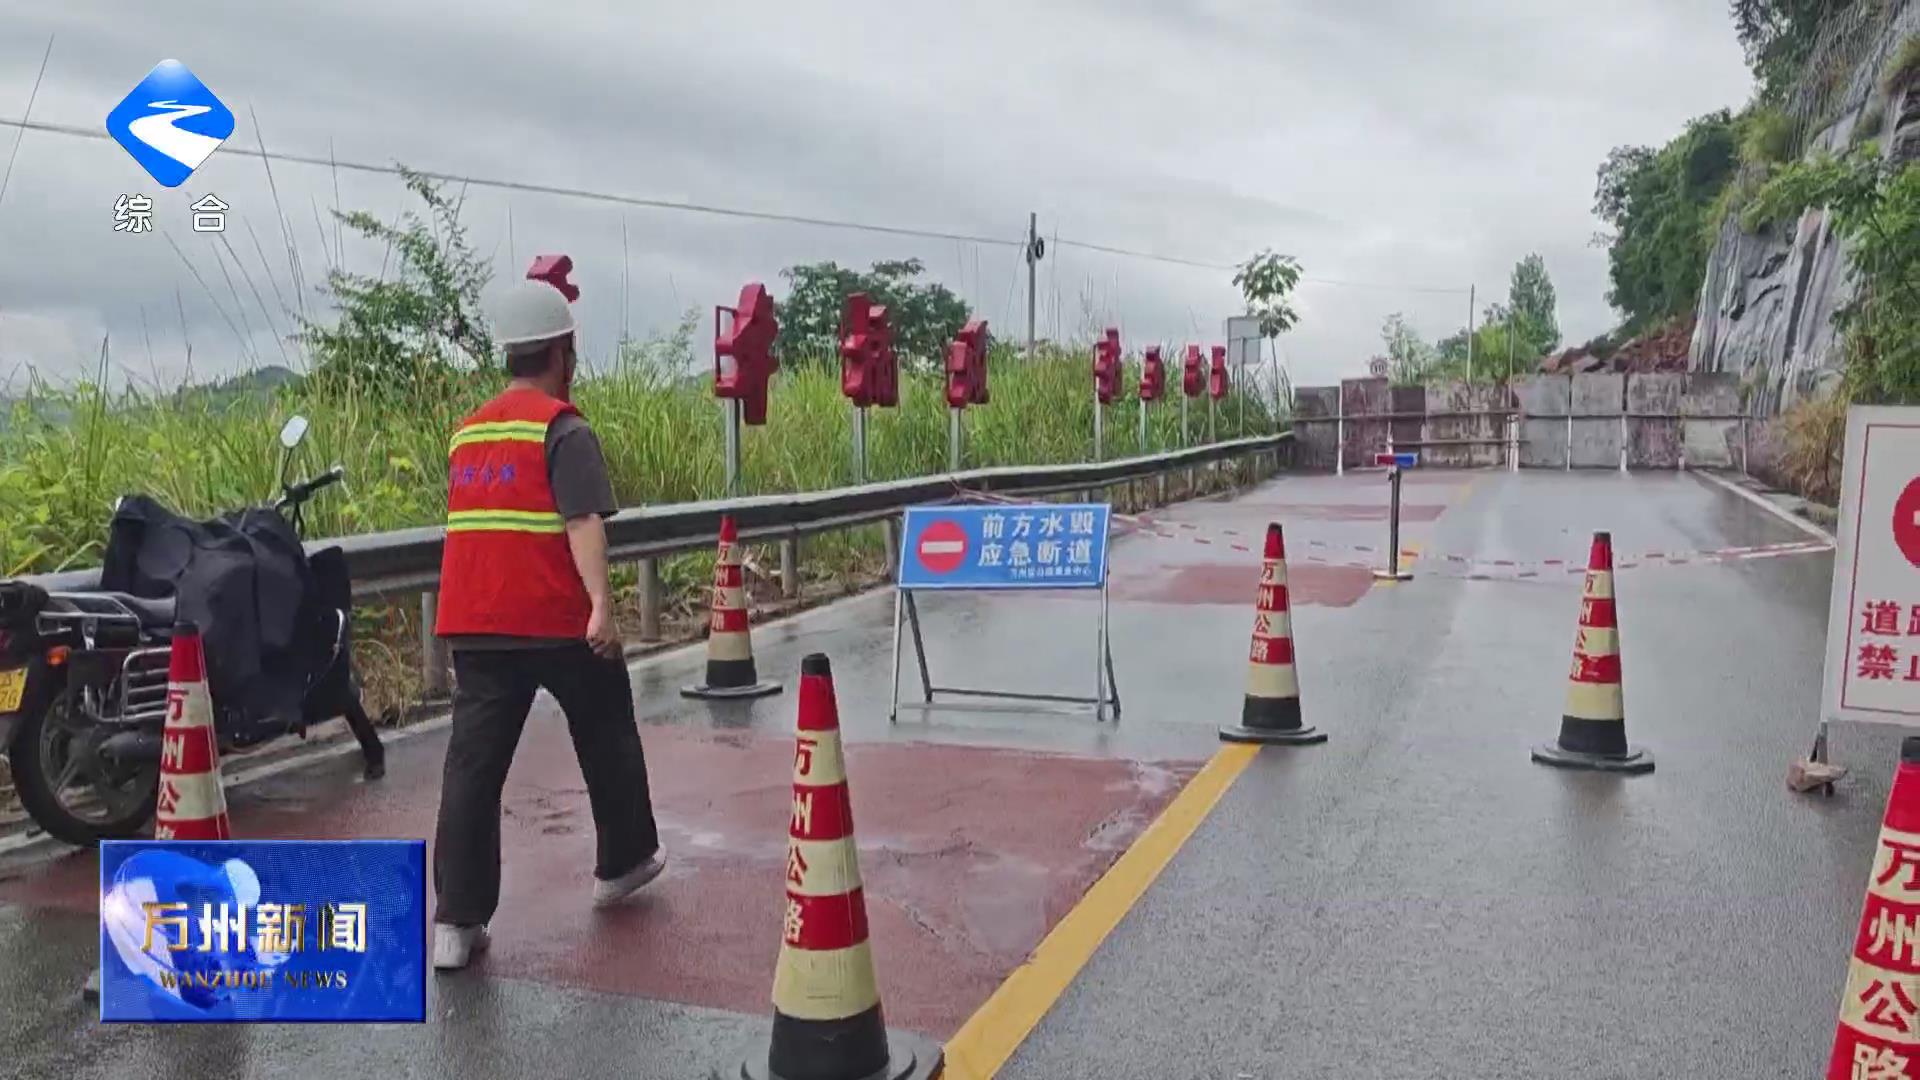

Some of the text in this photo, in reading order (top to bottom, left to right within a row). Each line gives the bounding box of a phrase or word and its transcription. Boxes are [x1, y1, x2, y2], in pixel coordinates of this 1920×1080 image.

[978, 540, 1093, 567] 应急断道
[982, 511, 1094, 538] 前方水毁
[1251, 562, 1277, 662] 万州公路
[783, 738, 818, 944] 万州公路
